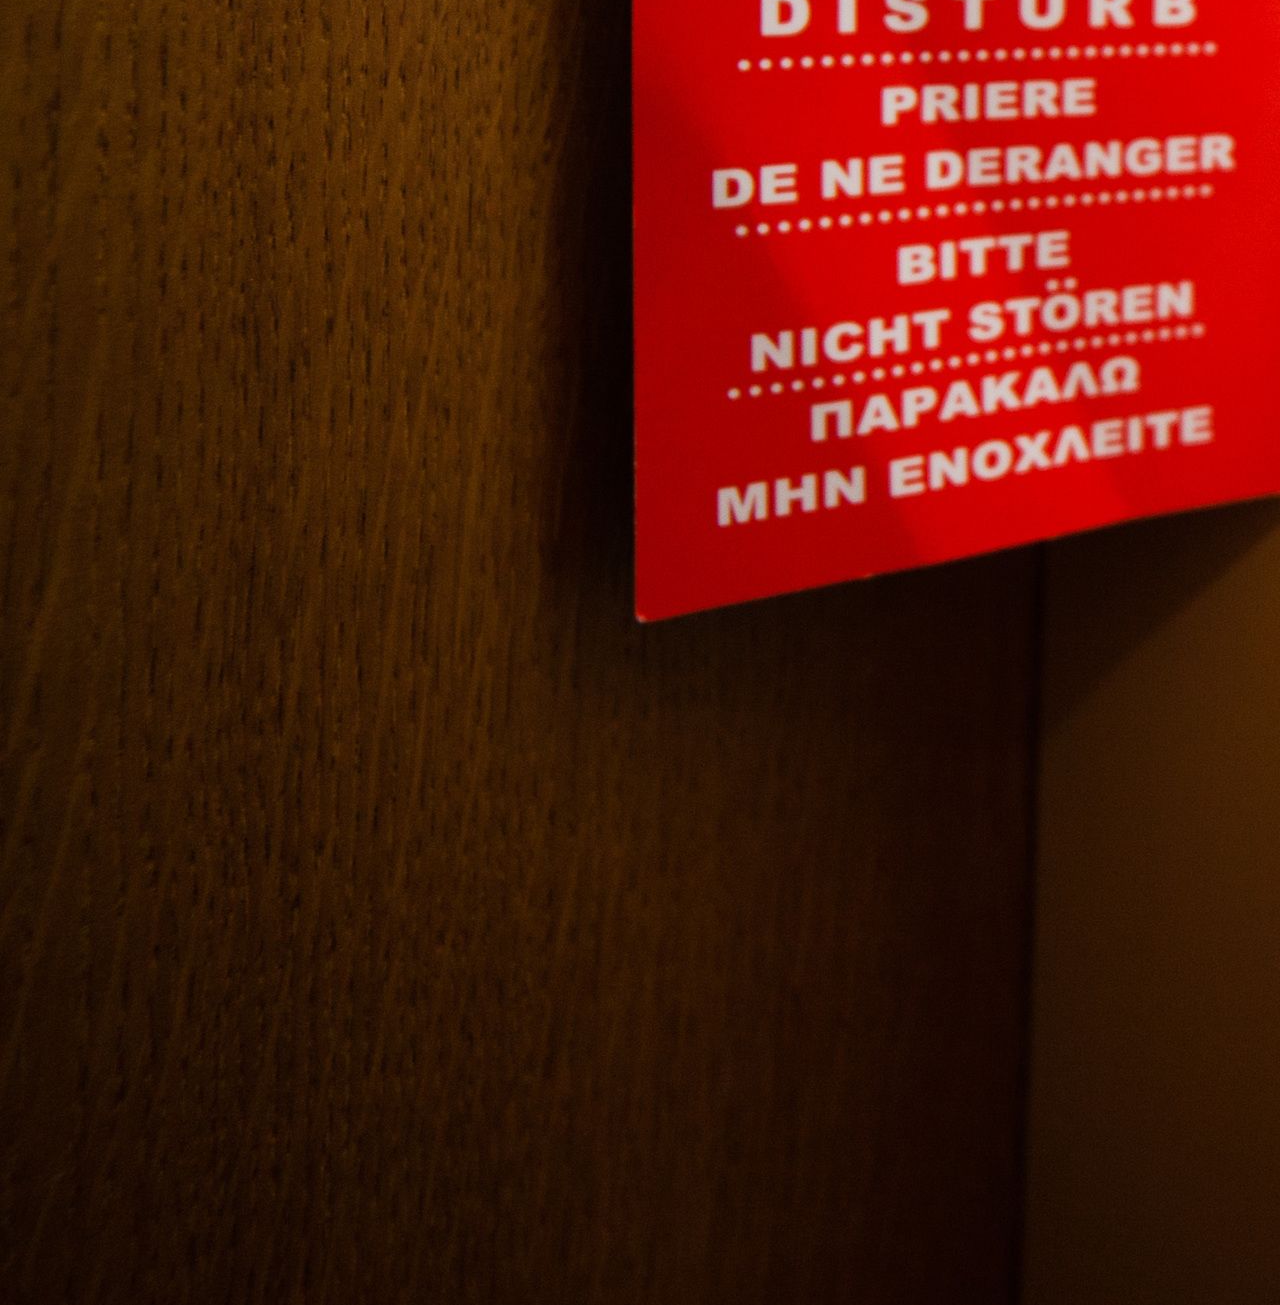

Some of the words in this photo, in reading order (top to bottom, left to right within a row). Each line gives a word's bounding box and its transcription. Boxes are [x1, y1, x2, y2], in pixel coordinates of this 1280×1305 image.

[880, 77, 1097, 127] PRIERE
[711, 162, 799, 209] DE
[820, 153, 906, 200] NE
[924, 133, 1236, 191] DERANGER
[896, 229, 1071, 286] BITTE
[750, 307, 952, 373] NICHT
[968, 277, 1195, 343] STÖREN
[810, 355, 1141, 442] ΠΑΡΑΚΑΛΩ
[716, 465, 867, 527] ΜΗΝ
[888, 405, 1213, 498] ΕΝΟΧΛΕΙΤΕ
